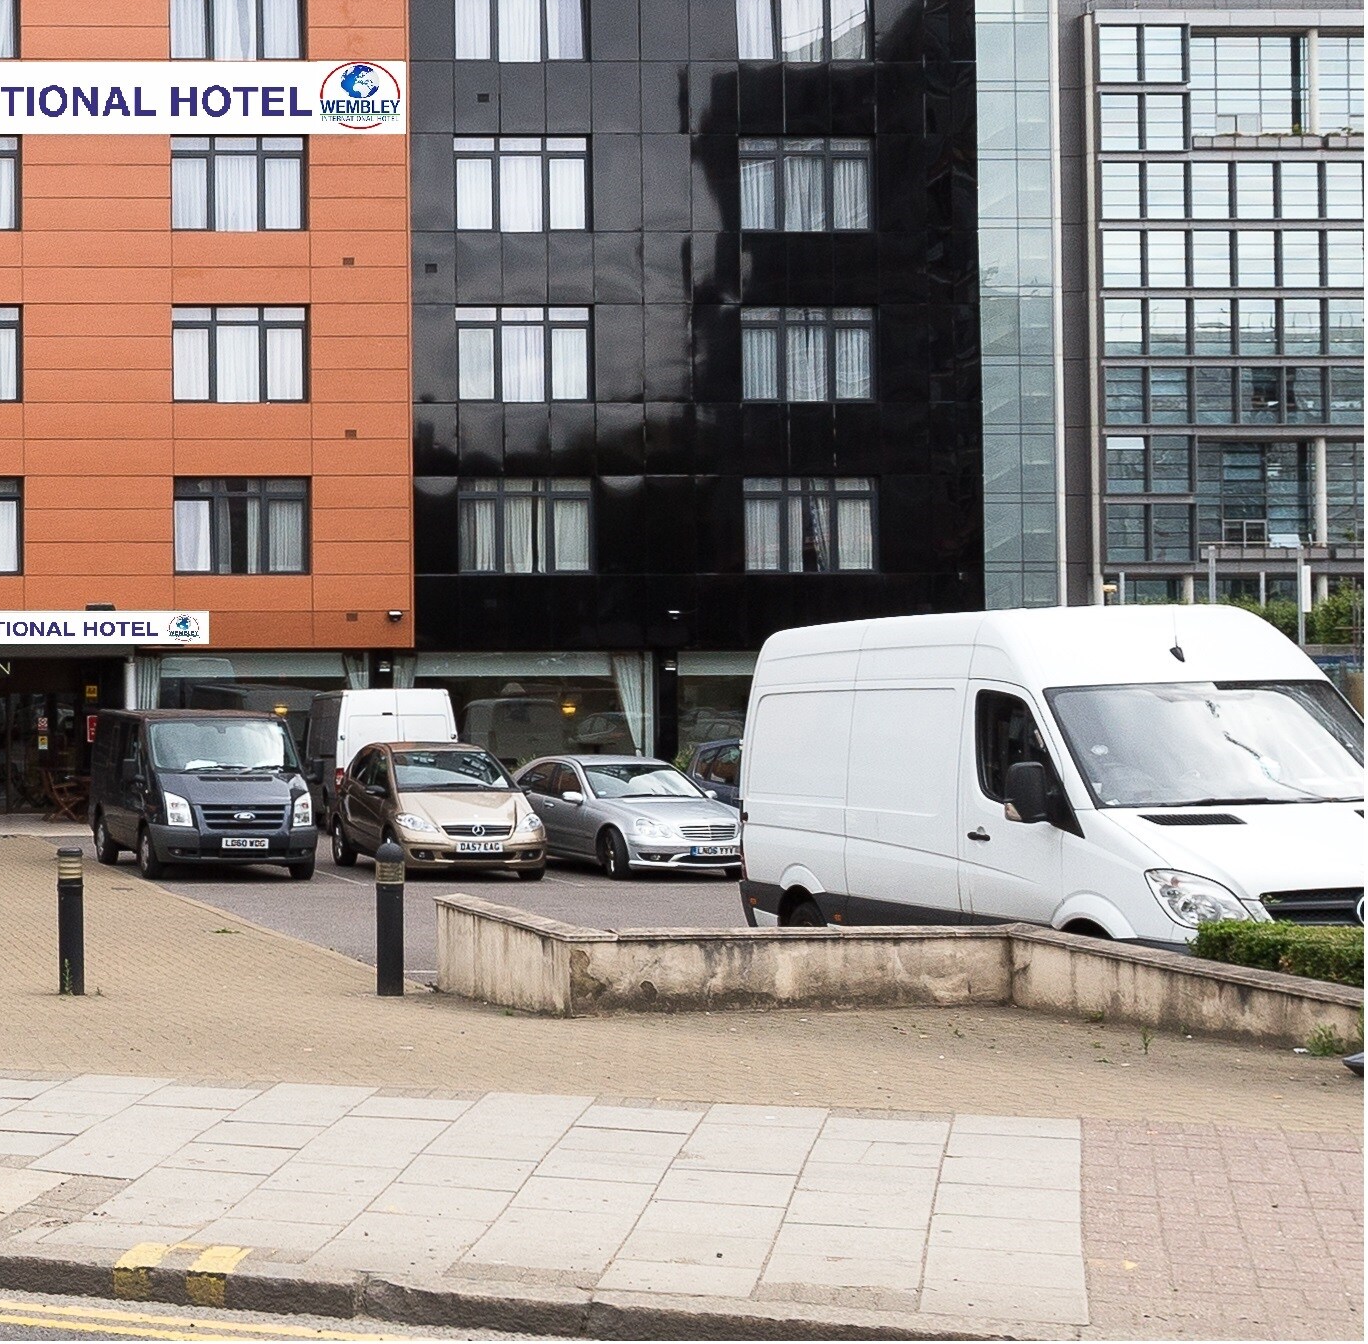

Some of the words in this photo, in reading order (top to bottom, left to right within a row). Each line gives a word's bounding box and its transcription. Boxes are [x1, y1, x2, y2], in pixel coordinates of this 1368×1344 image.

[171, 85, 312, 117] HOTEL
[320, 100, 400, 113] WEMBLEY
[84, 621, 158, 637] HOTEL
